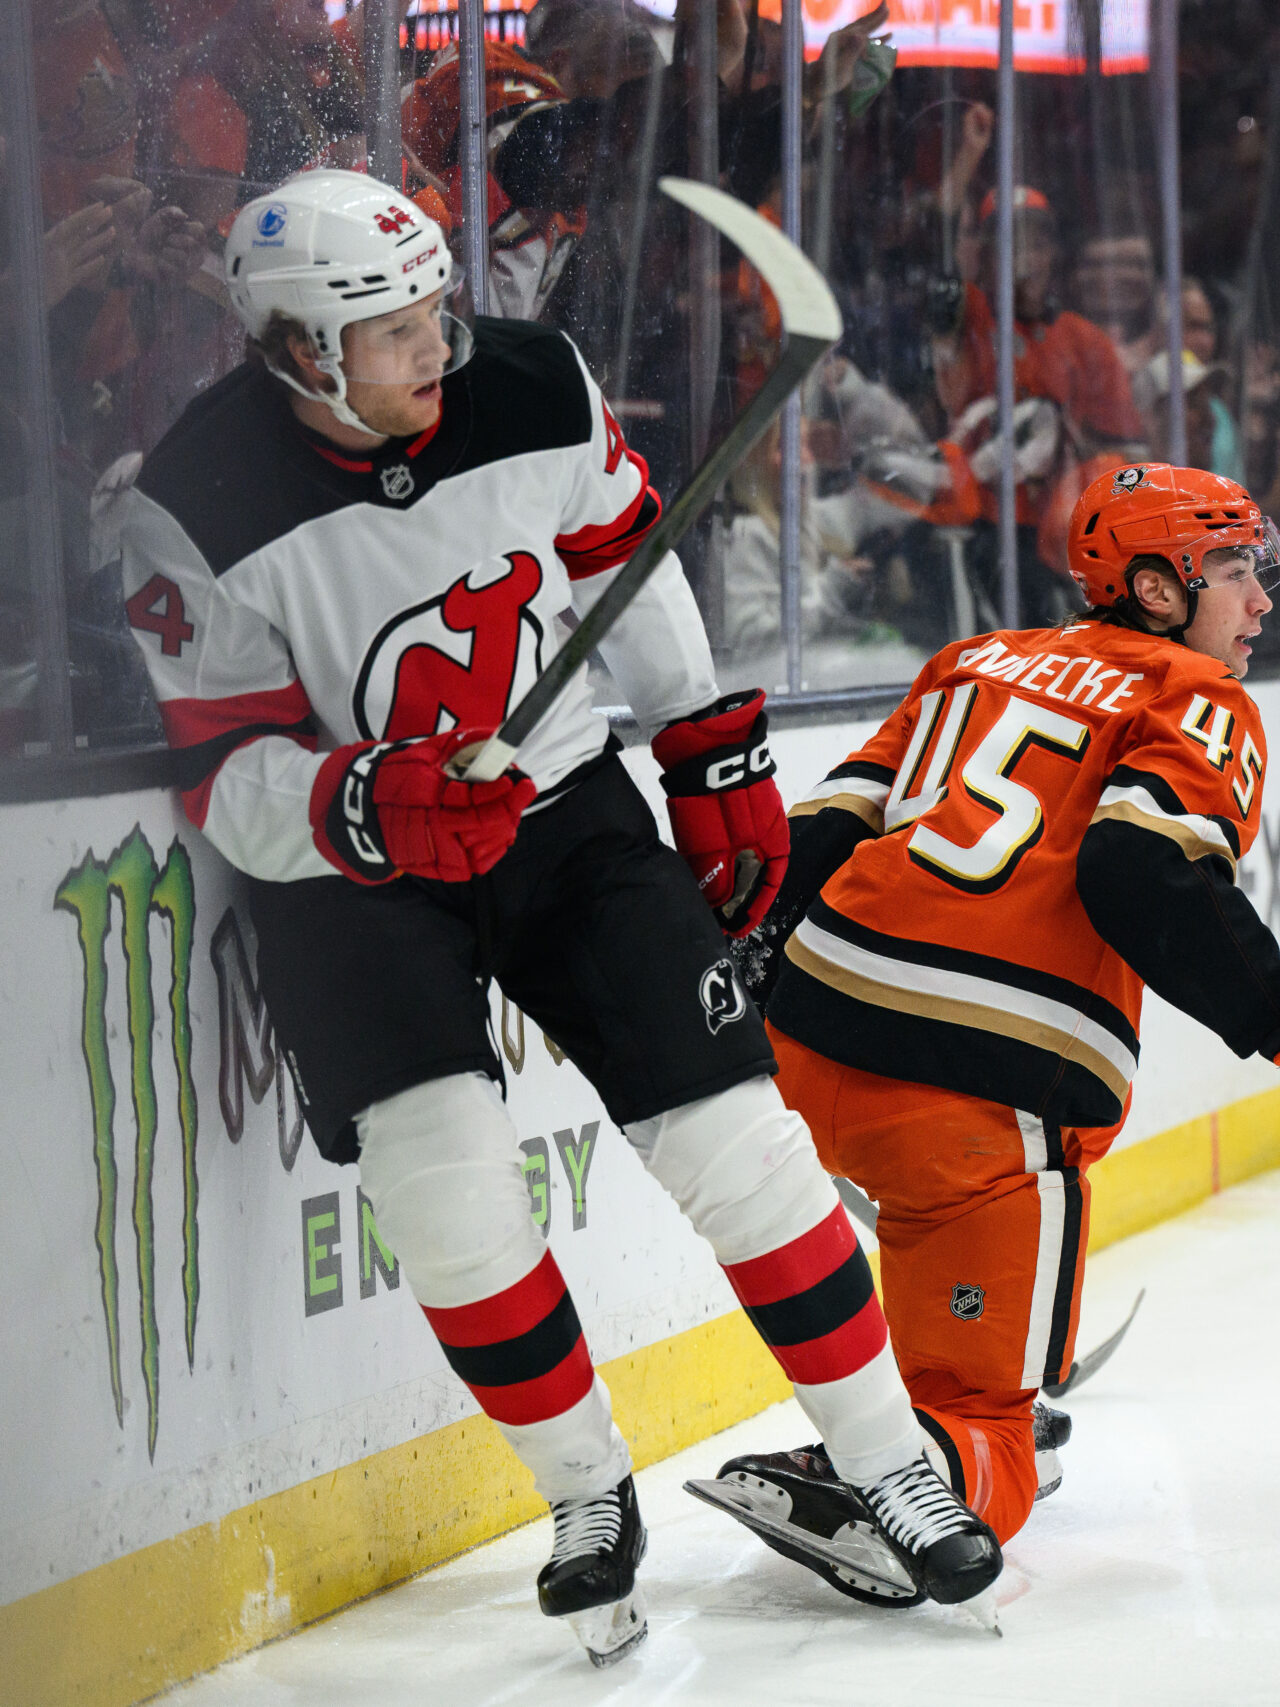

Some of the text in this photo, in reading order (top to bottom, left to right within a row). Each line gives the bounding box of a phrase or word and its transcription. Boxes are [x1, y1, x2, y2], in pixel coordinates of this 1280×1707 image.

[374, 206, 415, 235] 44
[402, 245, 438, 274] CCM
[706, 738, 771, 790] CC
[1180, 693, 1264, 822] 45
[698, 861, 724, 890] CCM
[300, 1120, 601, 1318] ENGY
